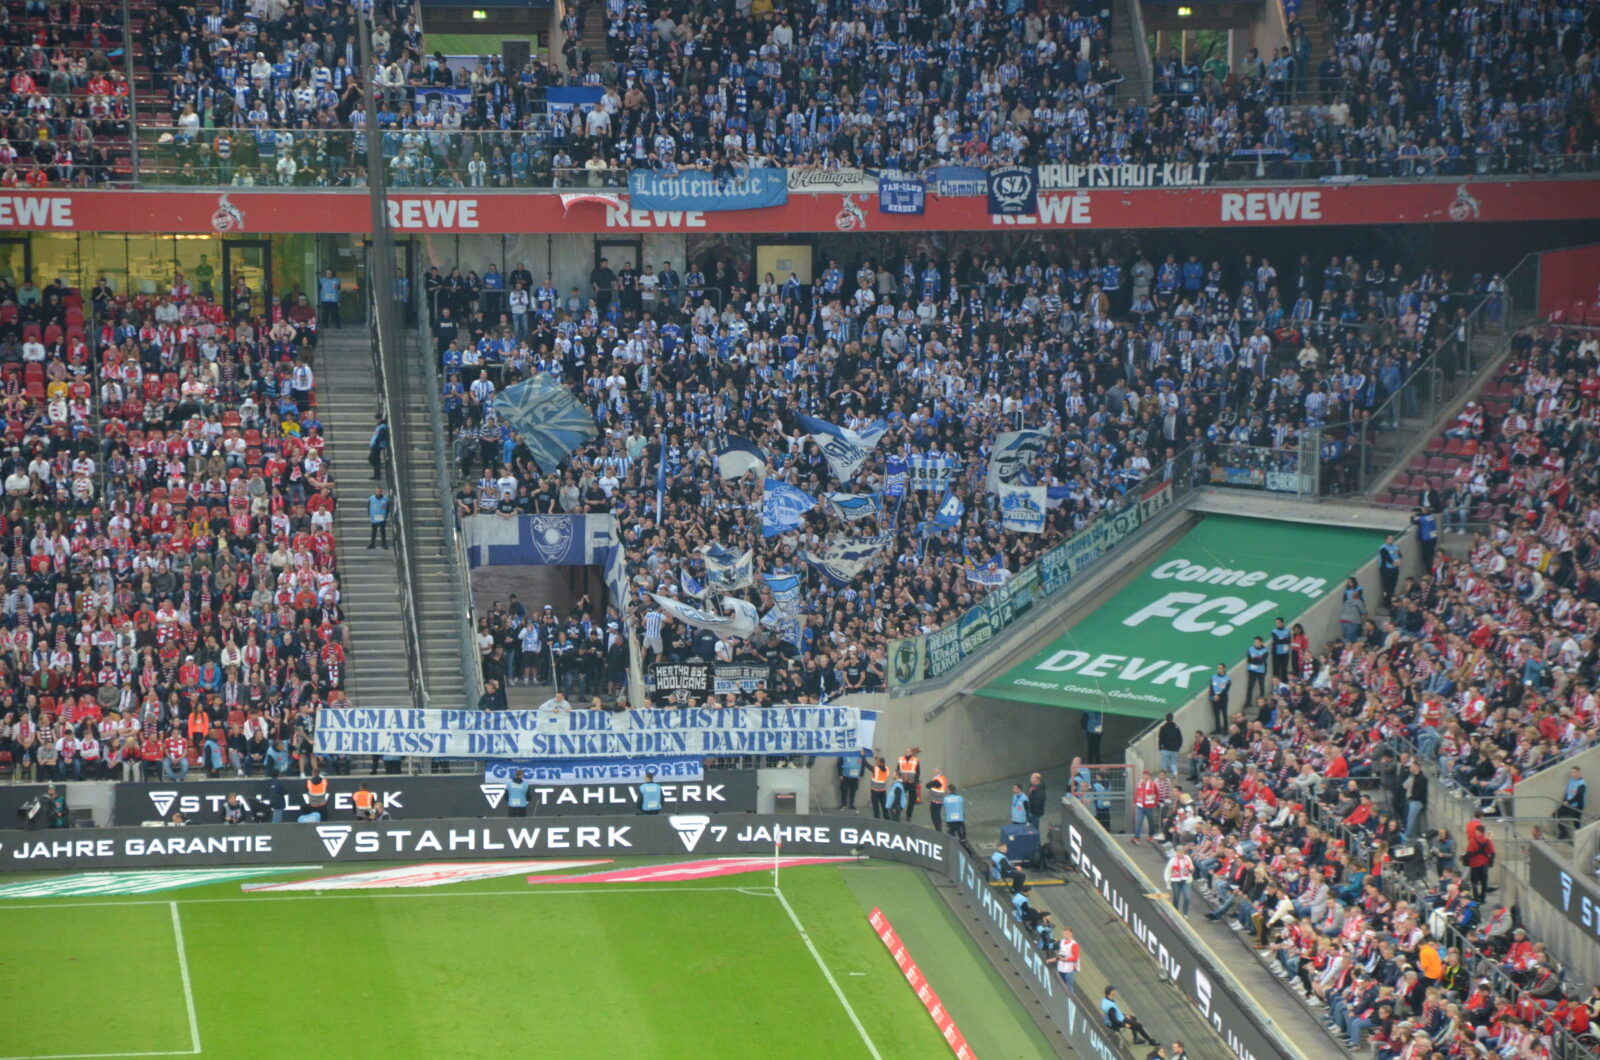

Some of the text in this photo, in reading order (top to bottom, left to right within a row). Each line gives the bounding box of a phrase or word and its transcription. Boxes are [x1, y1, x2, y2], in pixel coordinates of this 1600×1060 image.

[940, 183, 987, 197] Chemnitz
[1001, 175, 1024, 194] SZ
[1221, 192, 1322, 222] REWE
[909, 467, 951, 480] 1892
[1151, 559, 1328, 598] Come on,
[1122, 591, 1279, 636] FC!
[656, 665, 707, 677] HERTHA BSC
[1035, 649, 1211, 689] DEVK
[657, 675, 707, 690] HOOLIGANS
[319, 709, 425, 729] INGMAR
[441, 710, 537, 730] PERING
[569, 710, 613, 731] DIE
[628, 708, 747, 730] NÄCHSTE
[761, 707, 848, 729] RATTE
[316, 731, 452, 753] VERLÄSST
[468, 733, 519, 754] DEN
[533, 731, 688, 755] SINKENDEN
[702, 729, 831, 751] DAMPFER!
[493, 761, 700, 780] GEGEN INVESTOREN
[13, 835, 272, 859] JAHRE GARANTIE
[355, 826, 633, 852] STAHLWERK
[711, 826, 943, 861] 7 JAHRE GARANTIE
